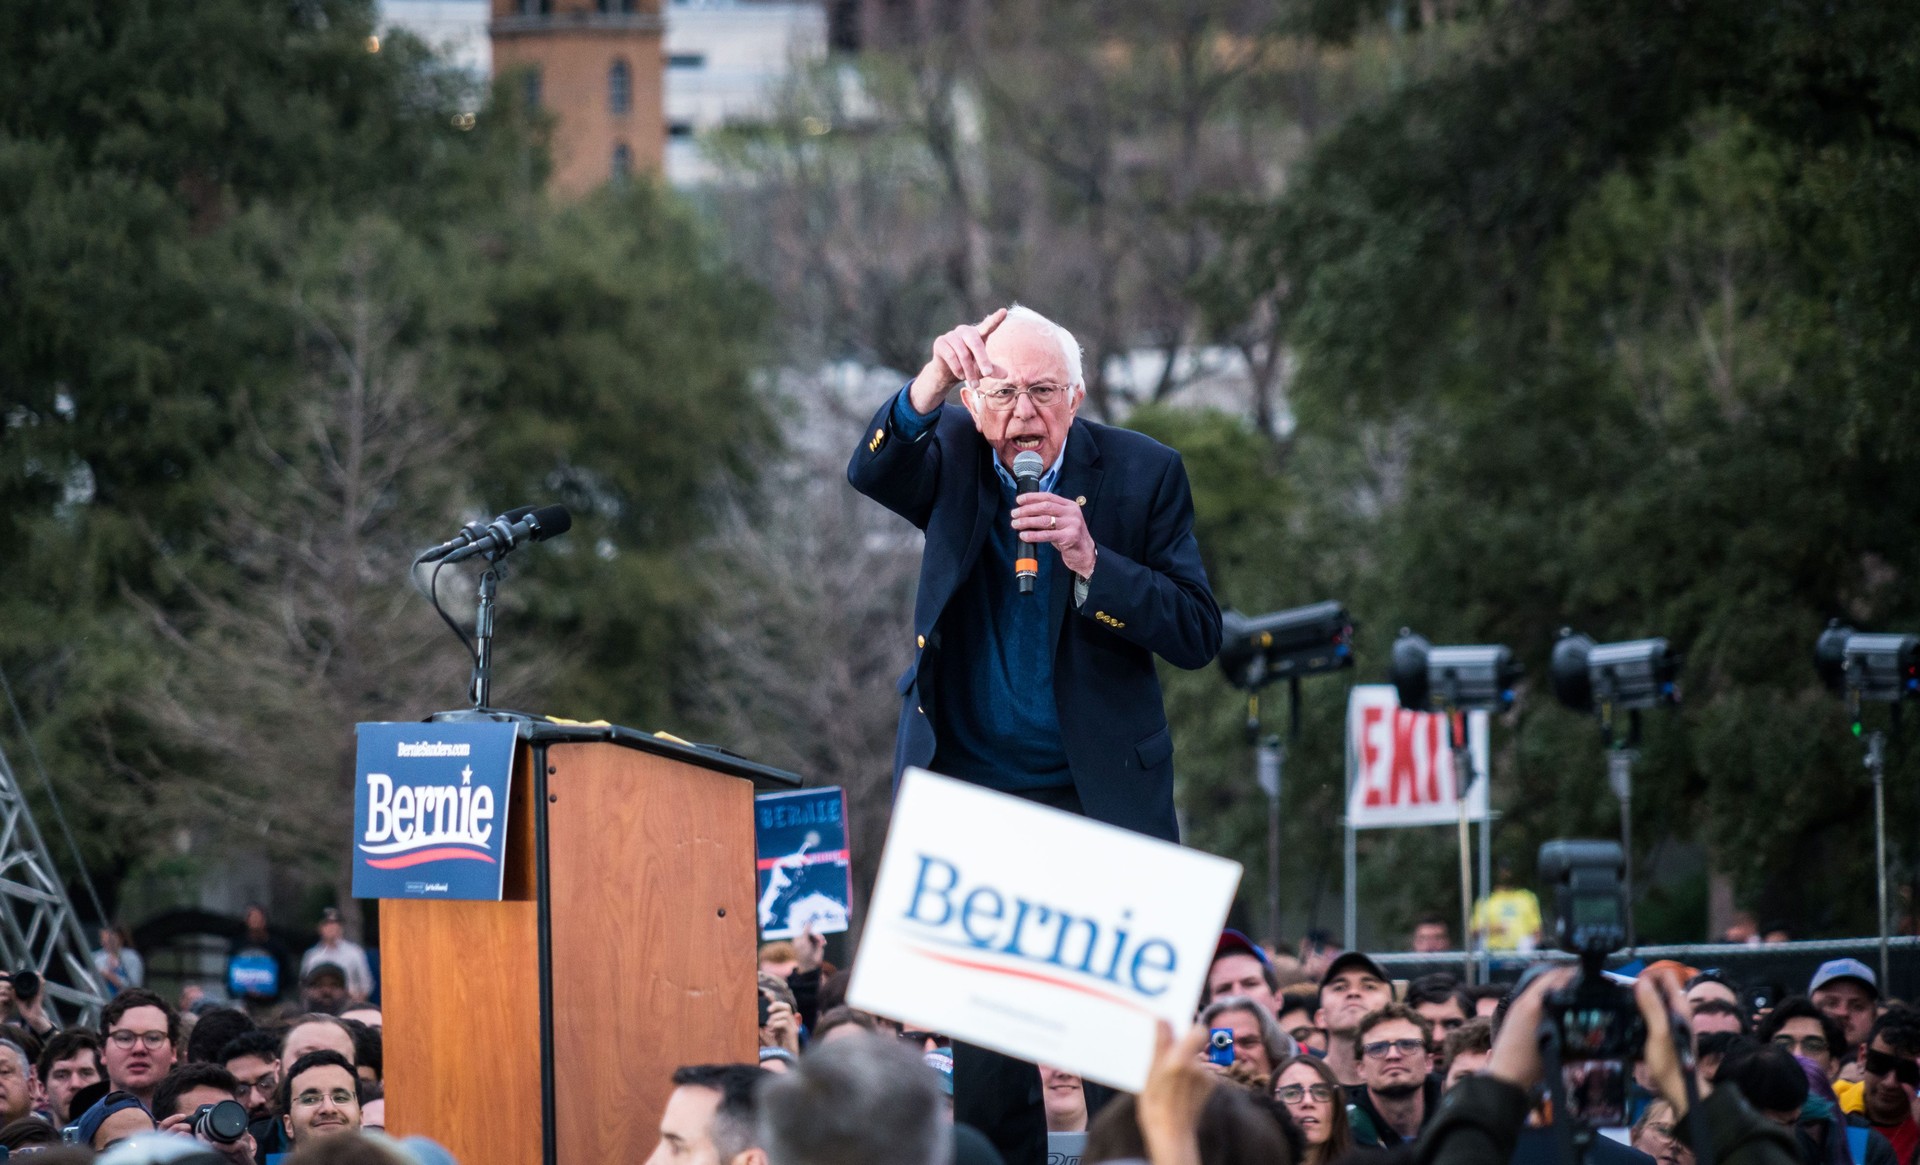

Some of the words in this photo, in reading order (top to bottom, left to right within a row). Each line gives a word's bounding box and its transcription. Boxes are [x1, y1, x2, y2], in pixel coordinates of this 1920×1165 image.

[397, 741, 471, 757] BernieSanders.com
[364, 764, 495, 843] Bernie
[759, 798, 841, 829] BERNIE
[903, 852, 1179, 997] Bernie
